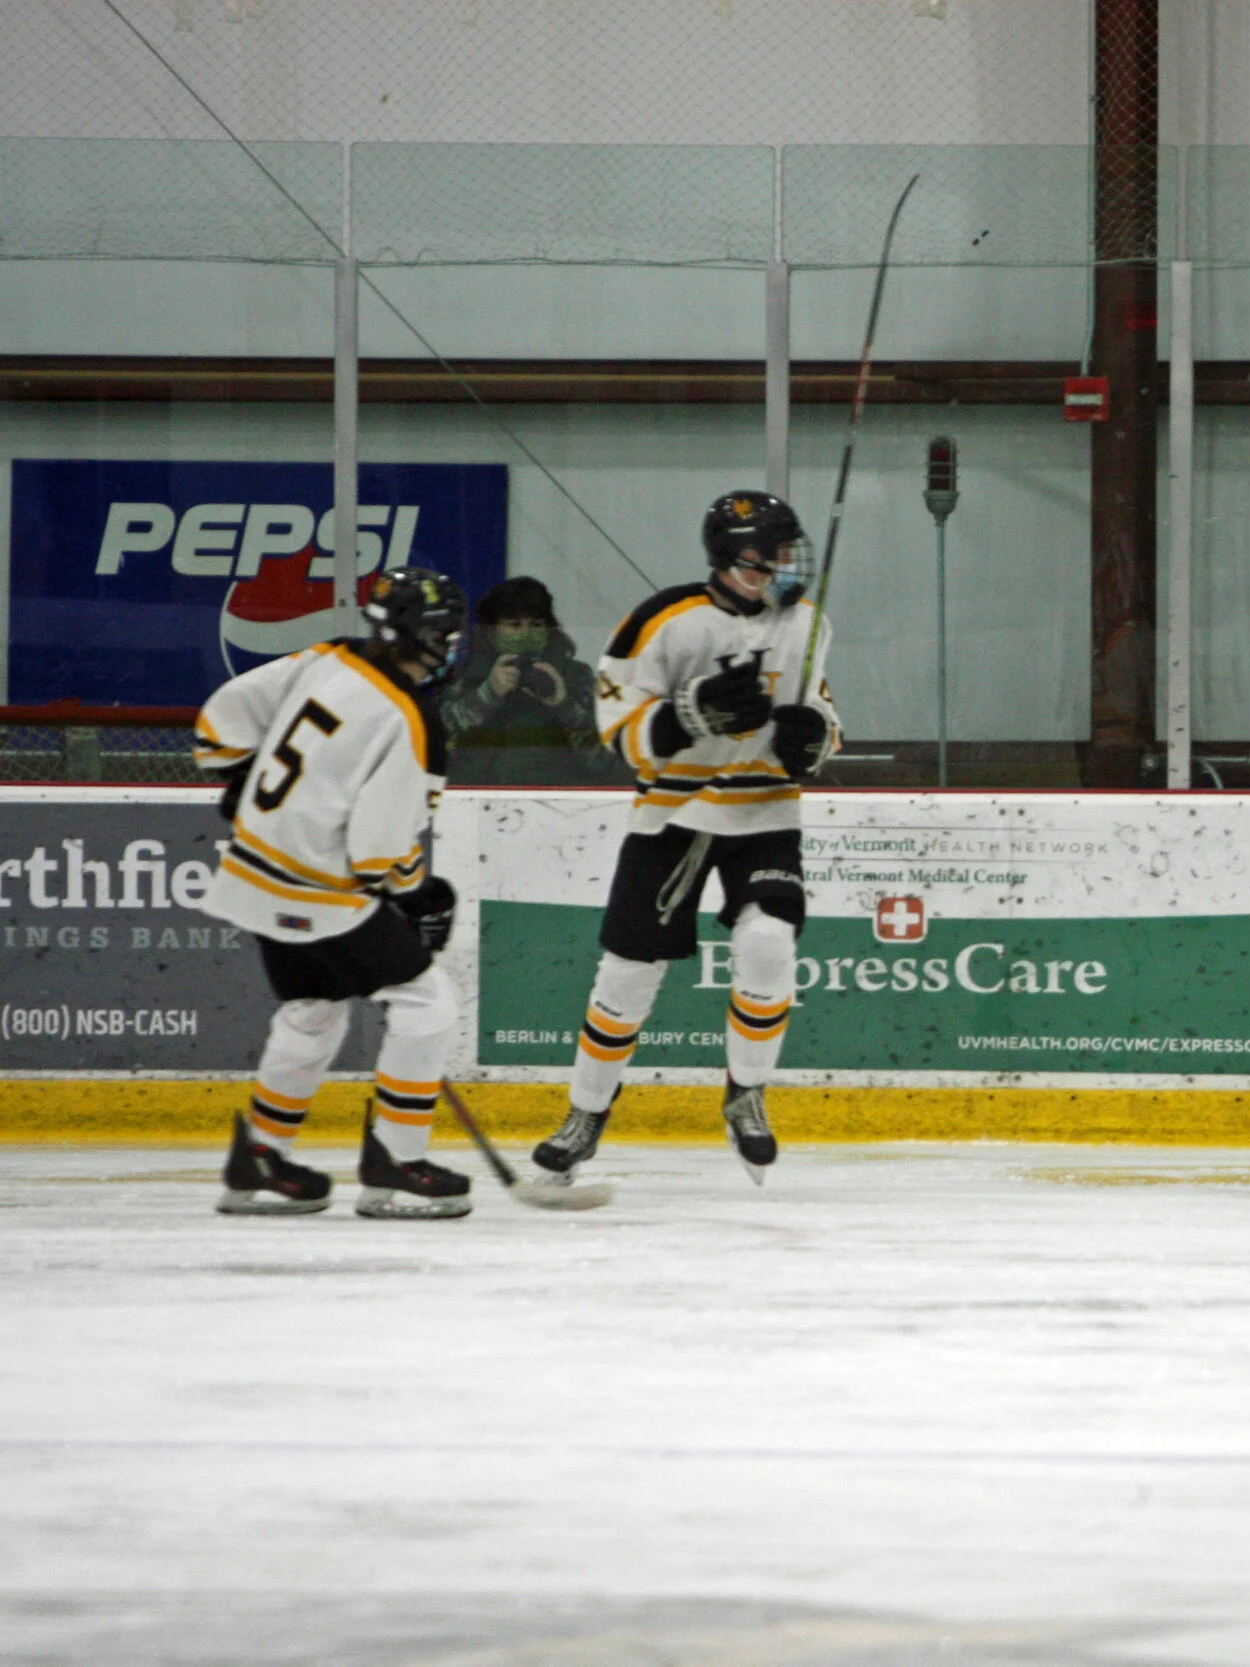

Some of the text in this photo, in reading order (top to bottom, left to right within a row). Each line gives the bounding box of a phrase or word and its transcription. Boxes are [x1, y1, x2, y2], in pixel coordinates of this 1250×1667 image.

[95, 501, 420, 578] PEPSI
[253, 697, 344, 814] 5
[842, 835, 916, 852] Vermont
[924, 840, 1000, 853] HEALTH
[1010, 841, 1109, 855] NETWORK
[0, 838, 231, 909] rthfie
[804, 867, 832, 883] tral
[837, 867, 904, 883] Vermont
[908, 867, 970, 884] Medical
[974, 870, 1028, 885] Center
[132, 926, 242, 949] BANK
[693, 941, 1108, 1007] EpressCare
[2, 1007, 198, 1039] (800) NSB-CASH
[495, 1030, 557, 1043] BERLIN
[561, 1030, 573, 1043] &
[689, 1032, 728, 1045] CEN
